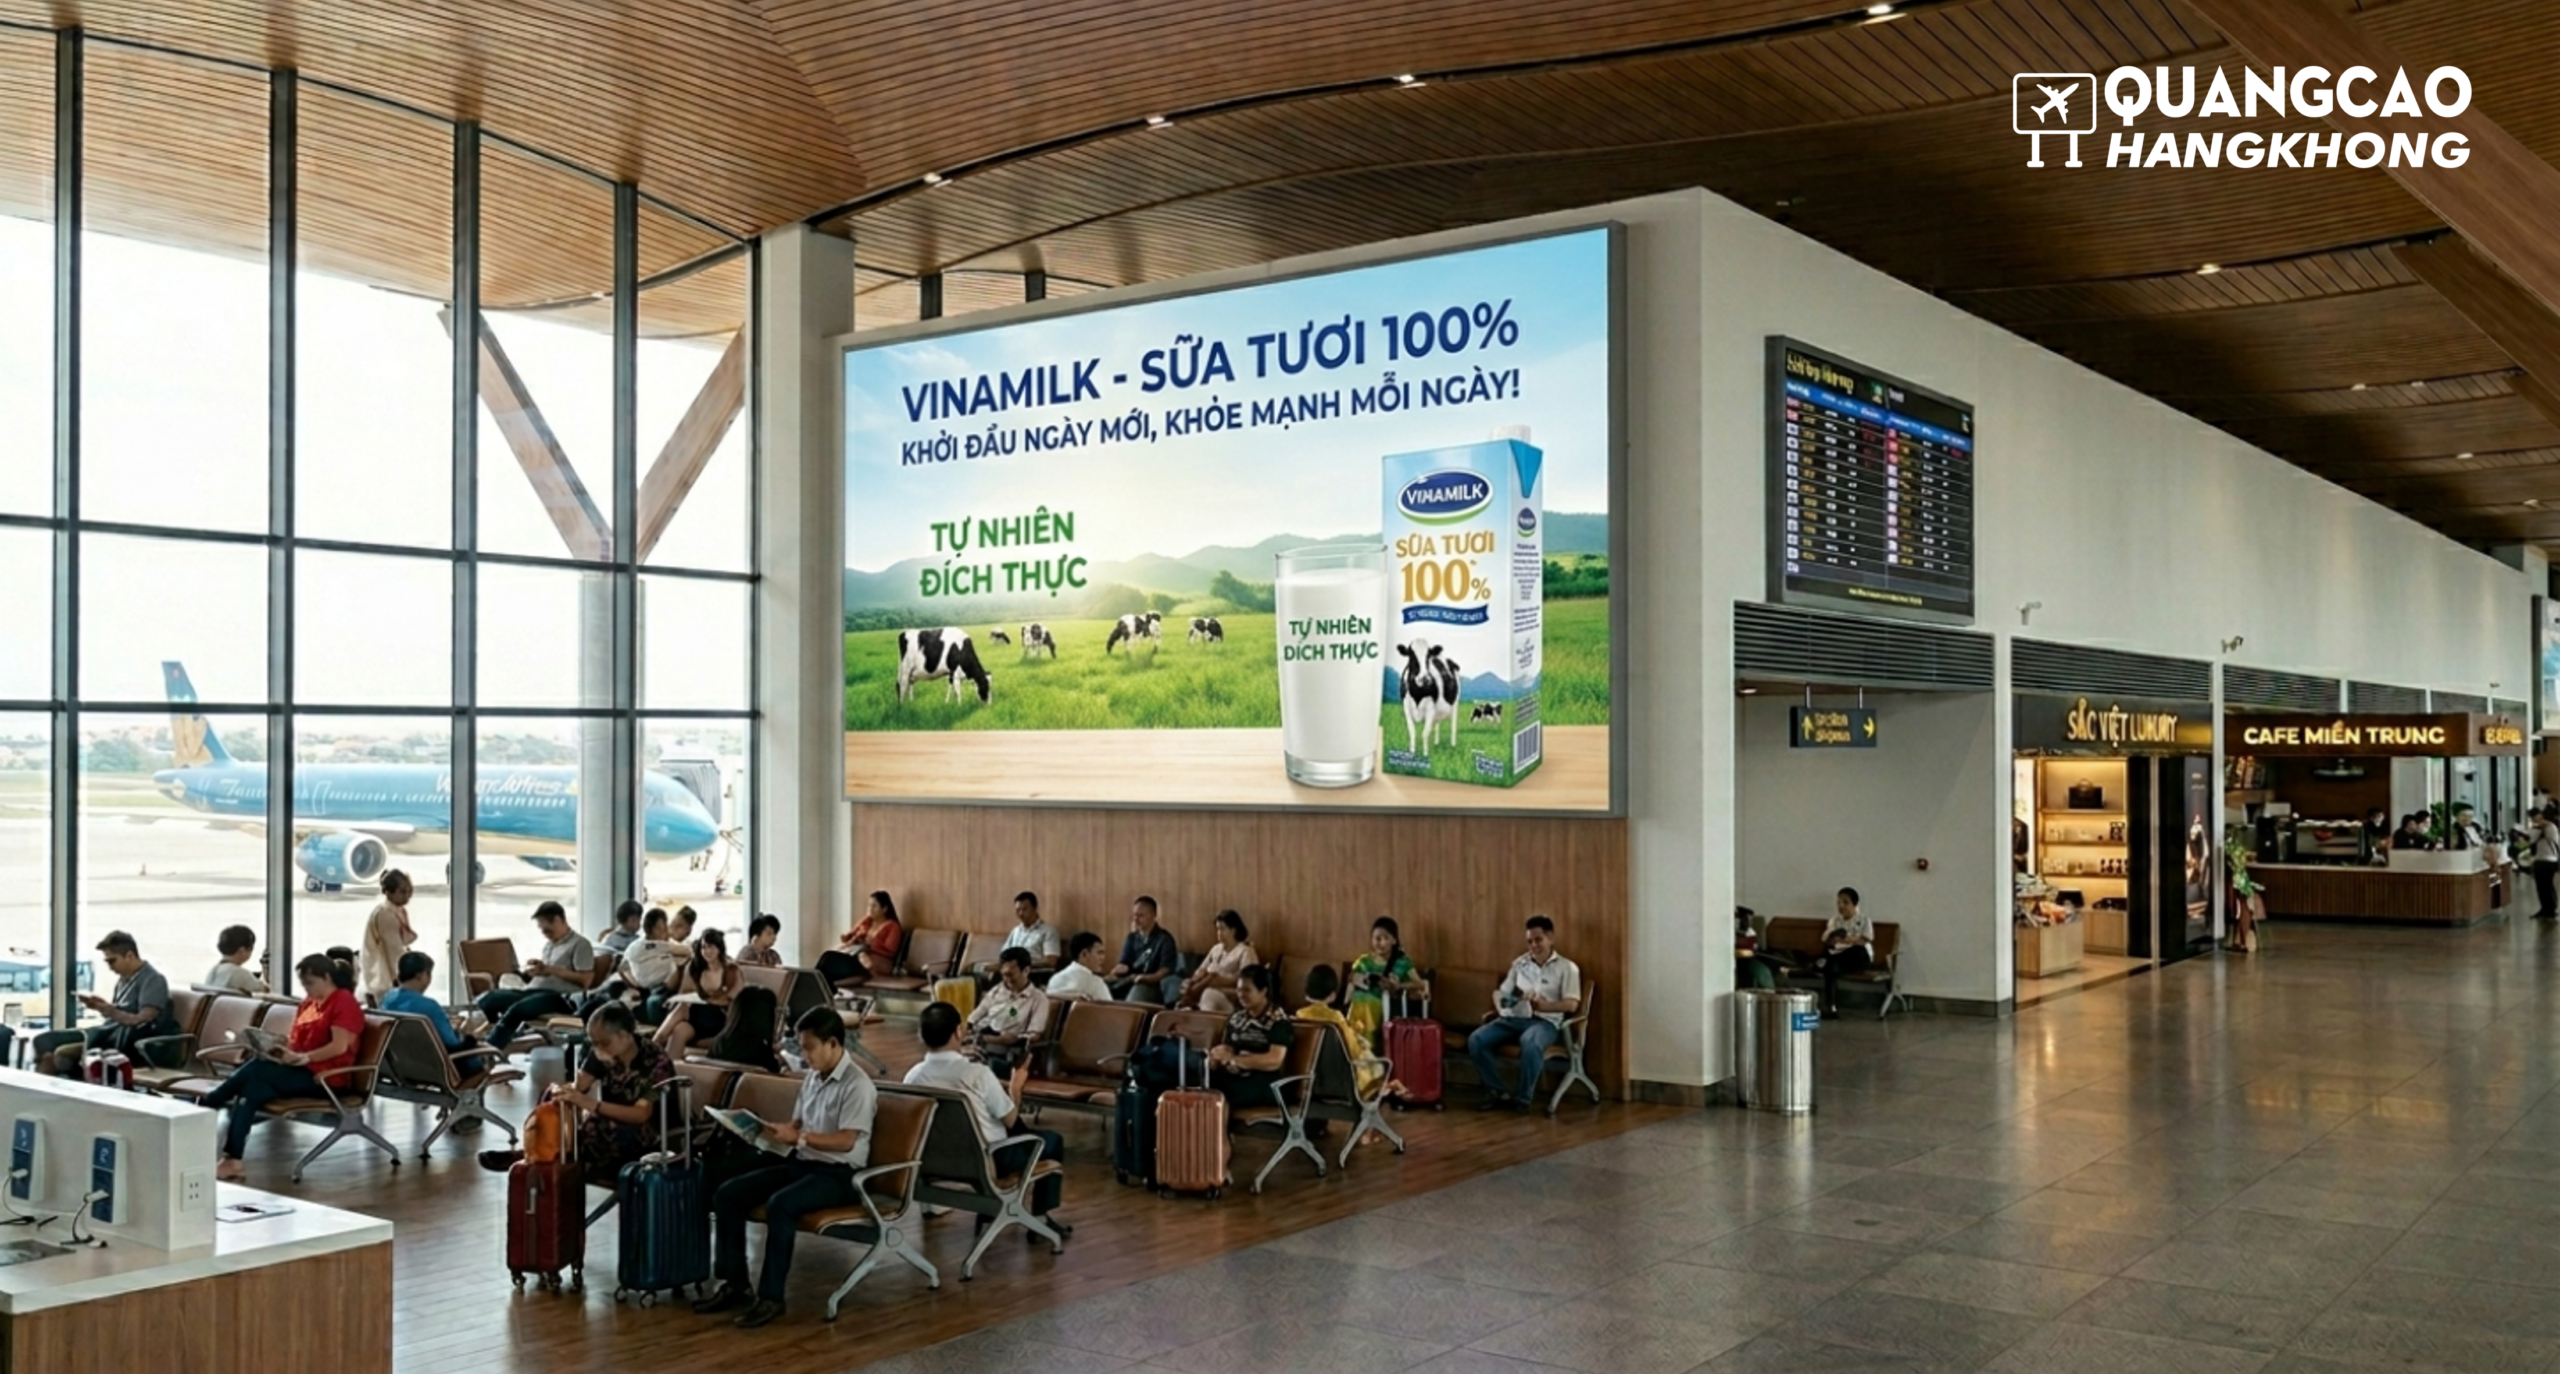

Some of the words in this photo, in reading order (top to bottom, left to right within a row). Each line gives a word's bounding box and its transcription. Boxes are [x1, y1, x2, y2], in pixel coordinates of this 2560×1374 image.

[902, 357, 1102, 423] VINAMILK
[1140, 334, 1236, 393] SỮA
[1247, 313, 1366, 379] TƯƠI
[1381, 298, 1520, 361] 100%
[1024, 416, 1094, 452] NGÀY
[1099, 408, 1157, 444] MỚI,
[1250, 390, 1341, 431] MẠNH
[1350, 370, 1410, 416] MỖI
[1420, 364, 1520, 409] NGÀY!
[930, 515, 971, 558] TỰ
[979, 505, 1074, 548] NHIÊN
[919, 559, 992, 597] ĐÍCH
[1001, 554, 1088, 598] THỰC
[1401, 558, 1492, 603] 100%
[1316, 614, 1372, 635] NHIÊN
[1329, 640, 1379, 664] THỰC
[2243, 726, 2301, 745] CAFE
[2365, 726, 2446, 745] TRUNG
